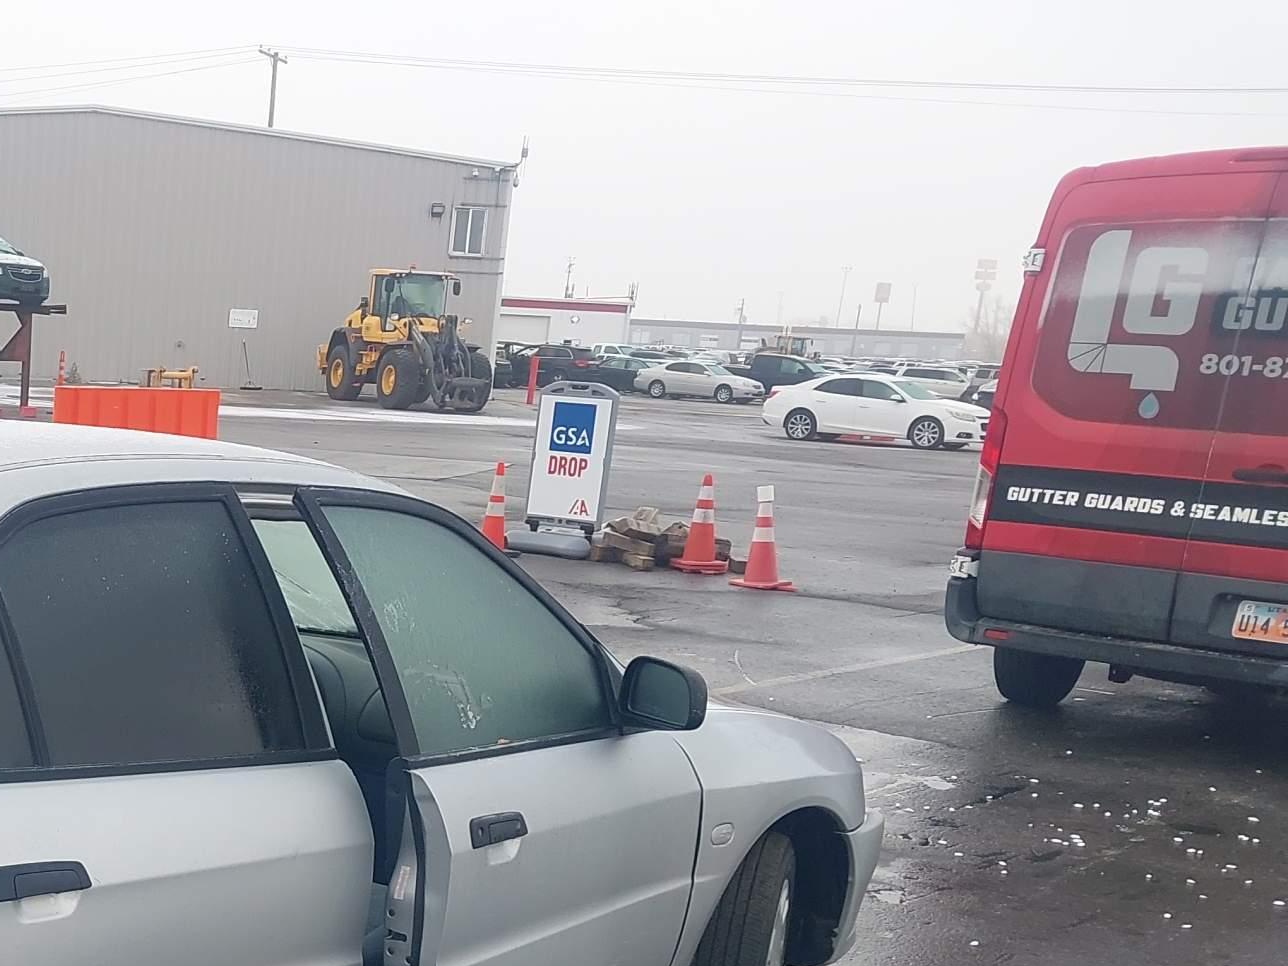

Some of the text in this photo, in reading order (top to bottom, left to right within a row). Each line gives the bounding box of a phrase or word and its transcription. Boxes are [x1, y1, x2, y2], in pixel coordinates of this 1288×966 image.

[553, 426, 590, 447] GSA
[548, 455, 589, 478] DROP
[1006, 486, 1288, 527] GUTTER GUARDS & SEAMLES
